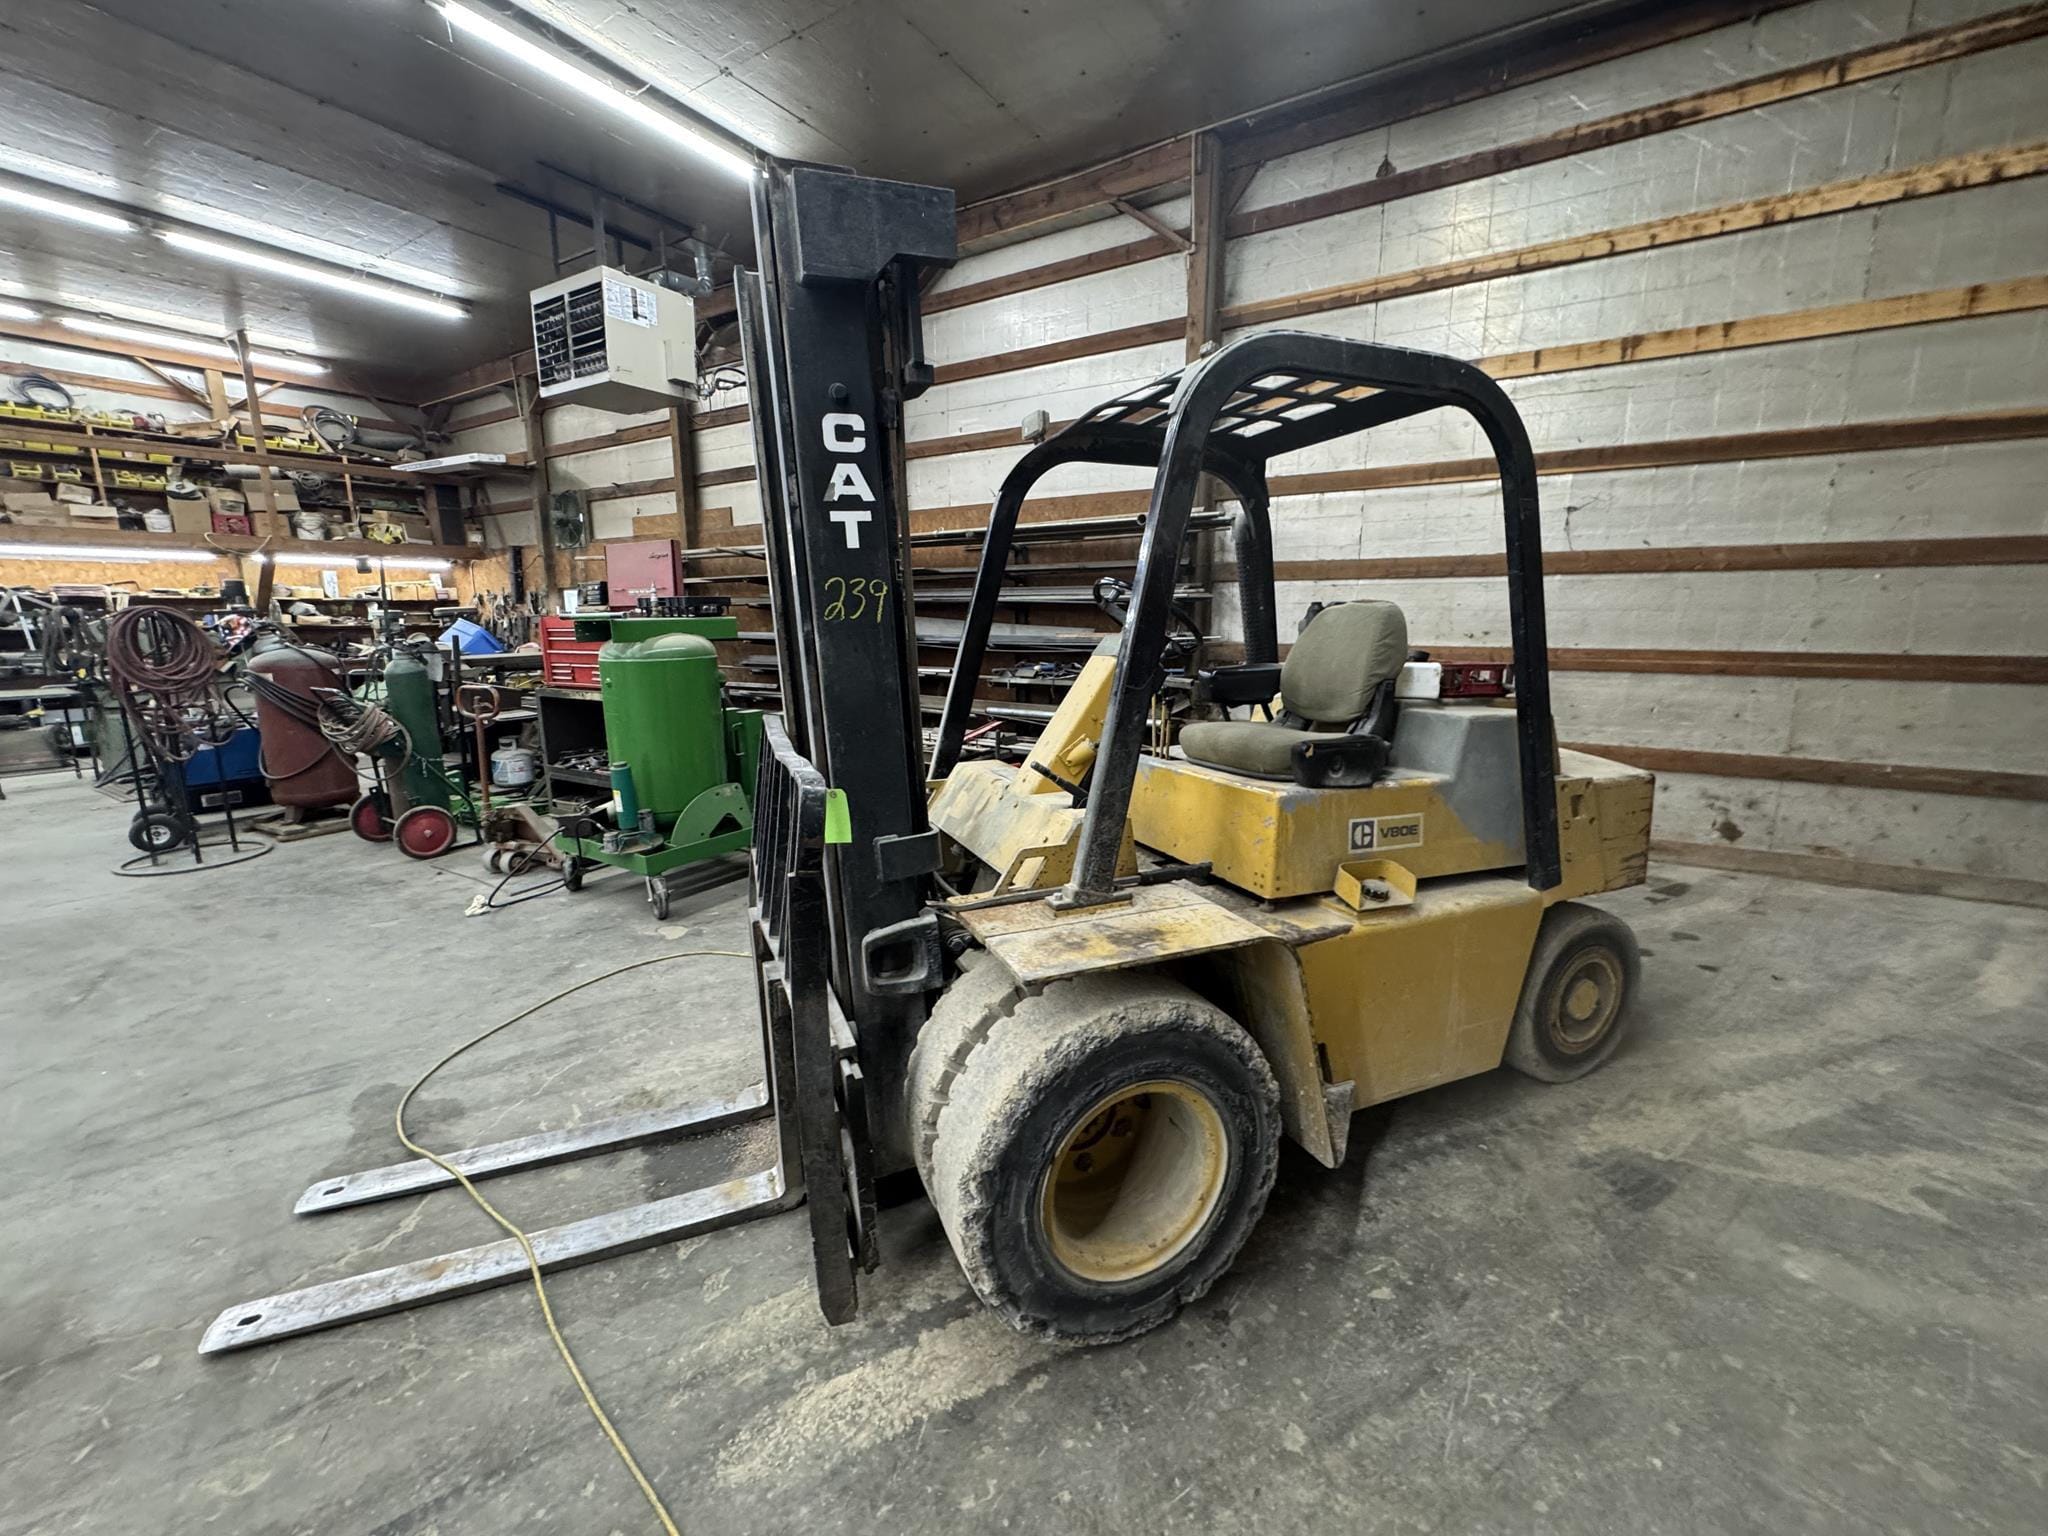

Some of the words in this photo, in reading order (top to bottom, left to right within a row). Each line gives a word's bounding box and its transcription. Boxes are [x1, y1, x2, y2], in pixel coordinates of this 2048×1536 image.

[822, 412, 876, 549] CAT
[823, 577, 888, 624] 239
[1380, 824, 1419, 838] V80E
